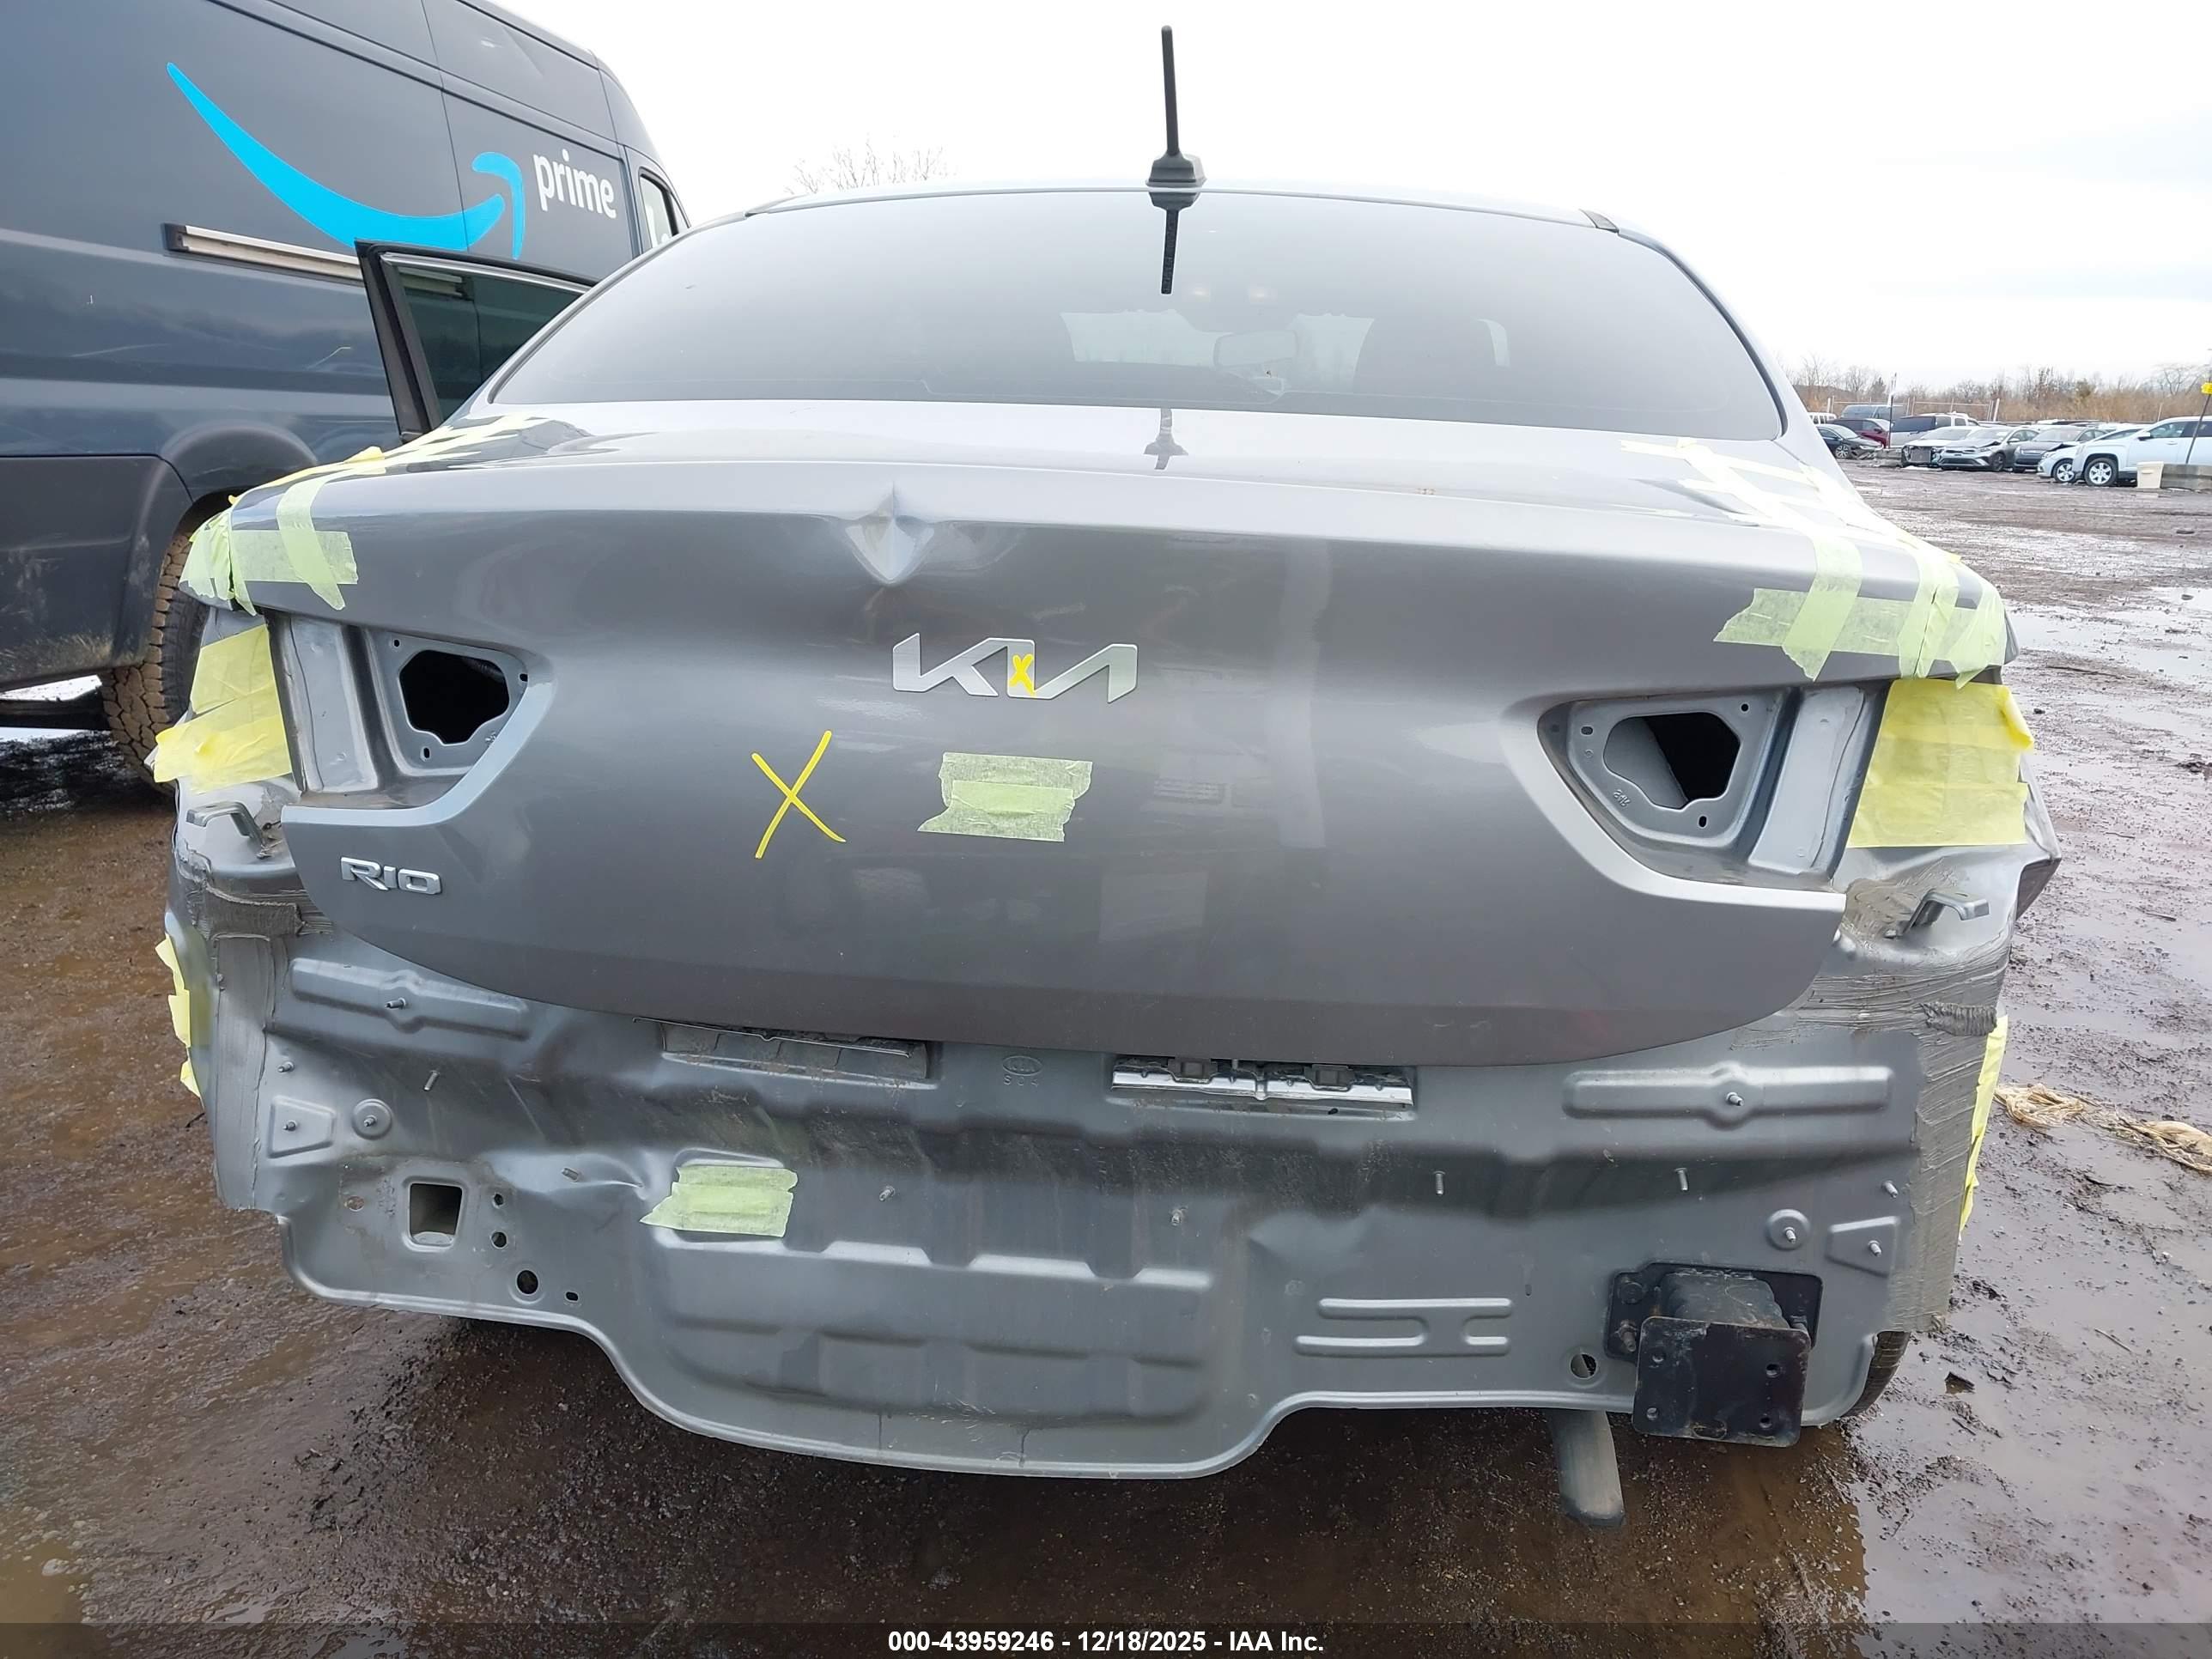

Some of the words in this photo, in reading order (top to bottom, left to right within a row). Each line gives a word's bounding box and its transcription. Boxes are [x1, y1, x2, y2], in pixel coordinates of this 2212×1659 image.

[533, 149, 617, 219] prime
[892, 633, 1138, 703] KIA
[340, 856, 442, 895] RIO
